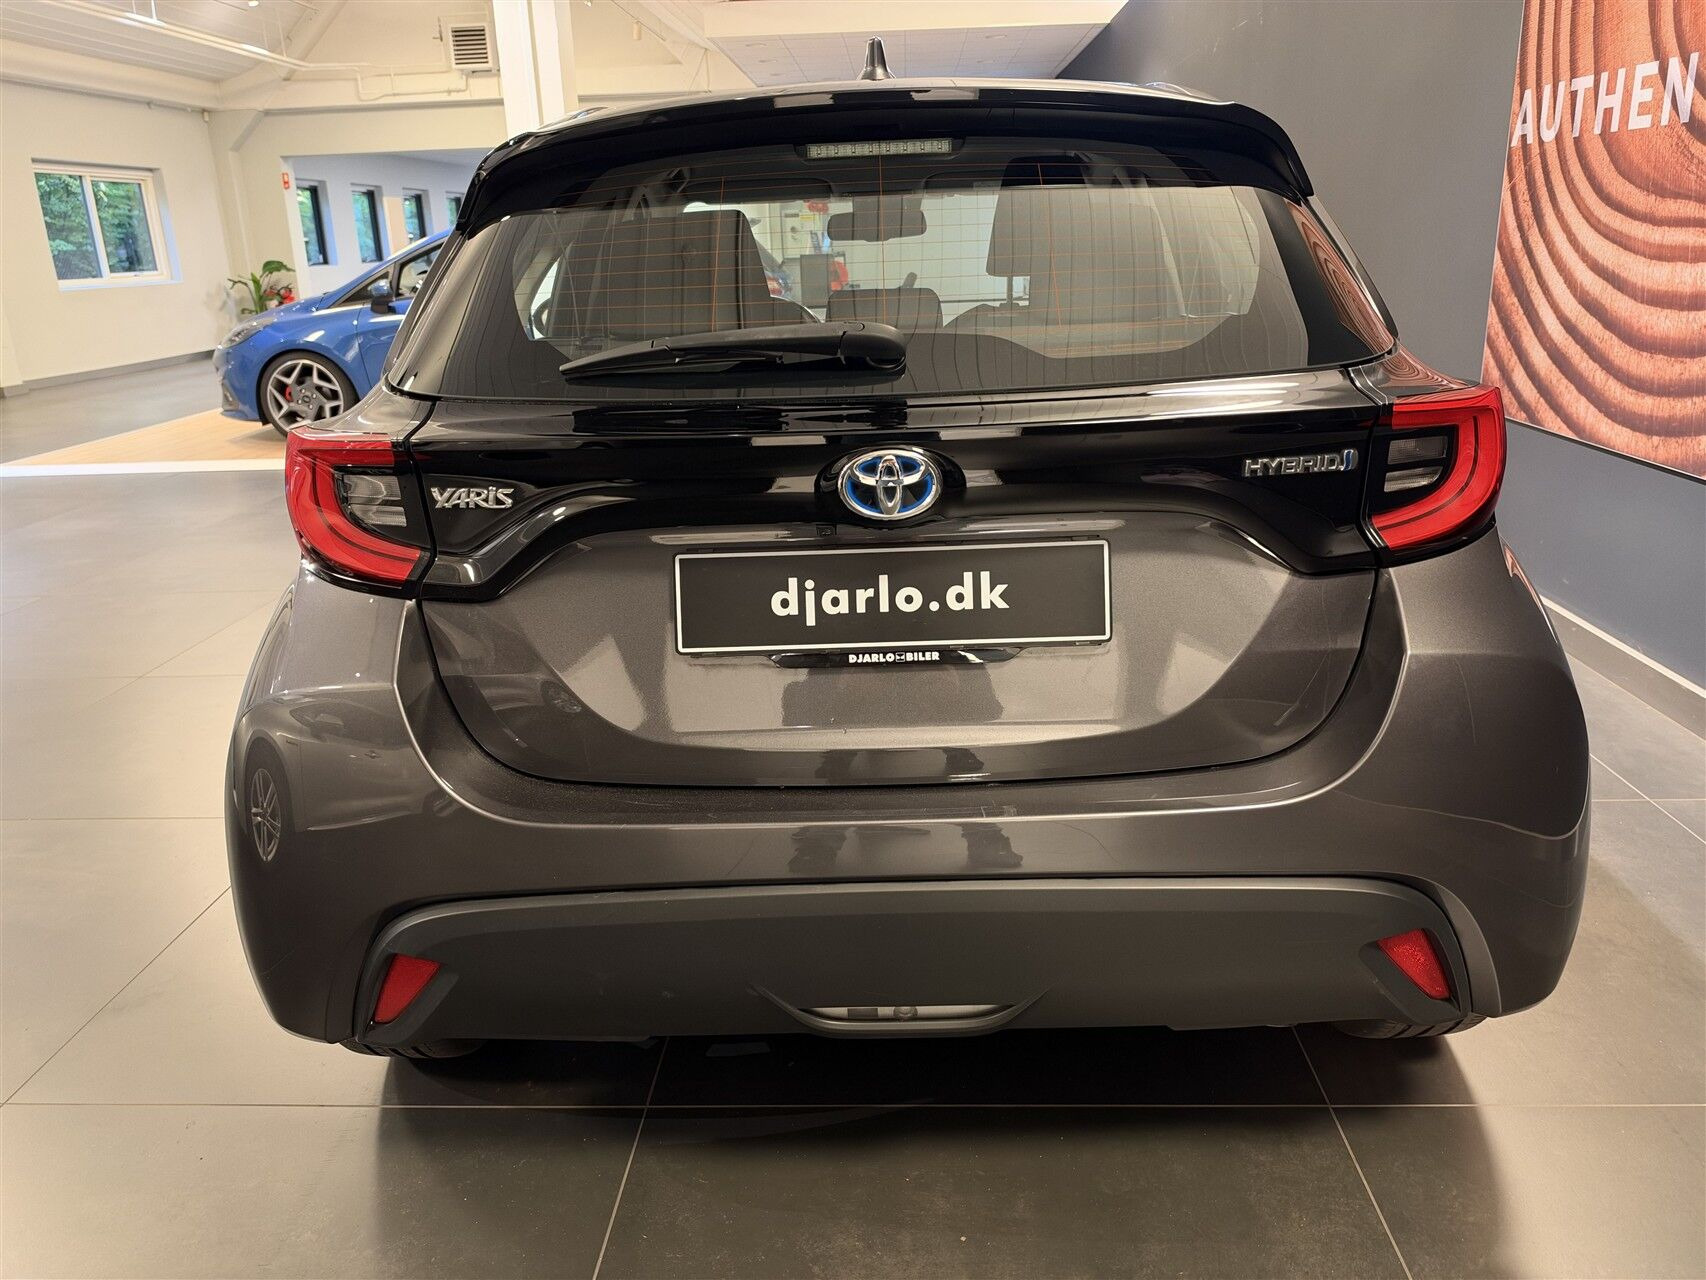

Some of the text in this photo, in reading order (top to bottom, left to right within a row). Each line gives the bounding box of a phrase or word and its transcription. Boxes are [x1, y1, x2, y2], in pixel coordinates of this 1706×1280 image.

[1510, 52, 1699, 147] AUTHEN
[1243, 453, 1341, 477] HYBRID
[770, 571, 1010, 627] djarlo.dk
[848, 651, 940, 663] DJARLO BILER
